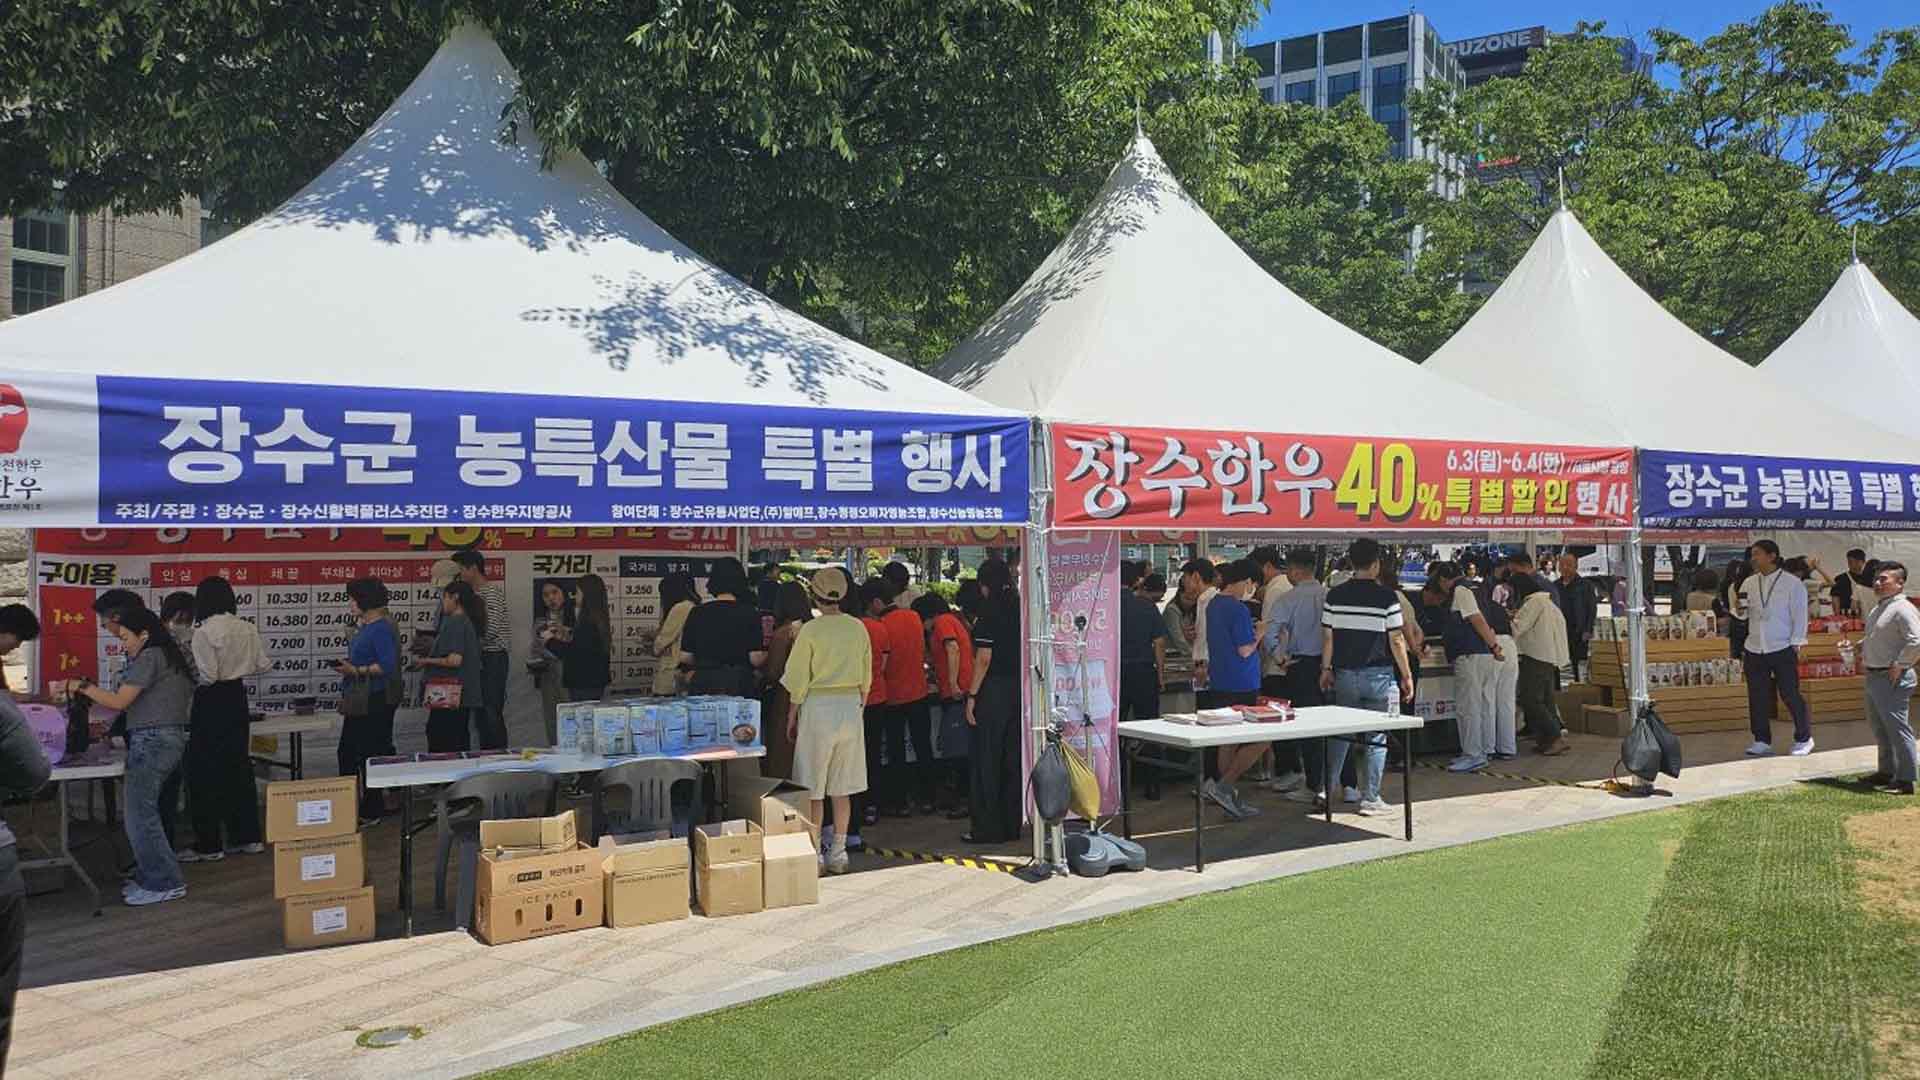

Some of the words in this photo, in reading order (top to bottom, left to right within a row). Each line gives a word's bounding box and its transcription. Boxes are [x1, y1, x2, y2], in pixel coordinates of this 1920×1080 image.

[160, 406, 416, 486] 장수군
[455, 415, 731, 490] 농특산물
[761, 426, 874, 492] 특별
[901, 431, 1006, 494] 행사
[1064, 432, 1334, 517] 장수한우
[1335, 442, 1442, 521] 40%
[1666, 464, 1748, 508] 장수군
[1758, 467, 1852, 511] 농특산물
[1860, 471, 1903, 513] 특별
[215, 503, 264, 519] 장수군
[1576, 480, 1628, 516] 행사
[39, 561, 116, 585] 구이용
[532, 555, 592, 574] 국거리
[53, 608, 85, 625] 1++
